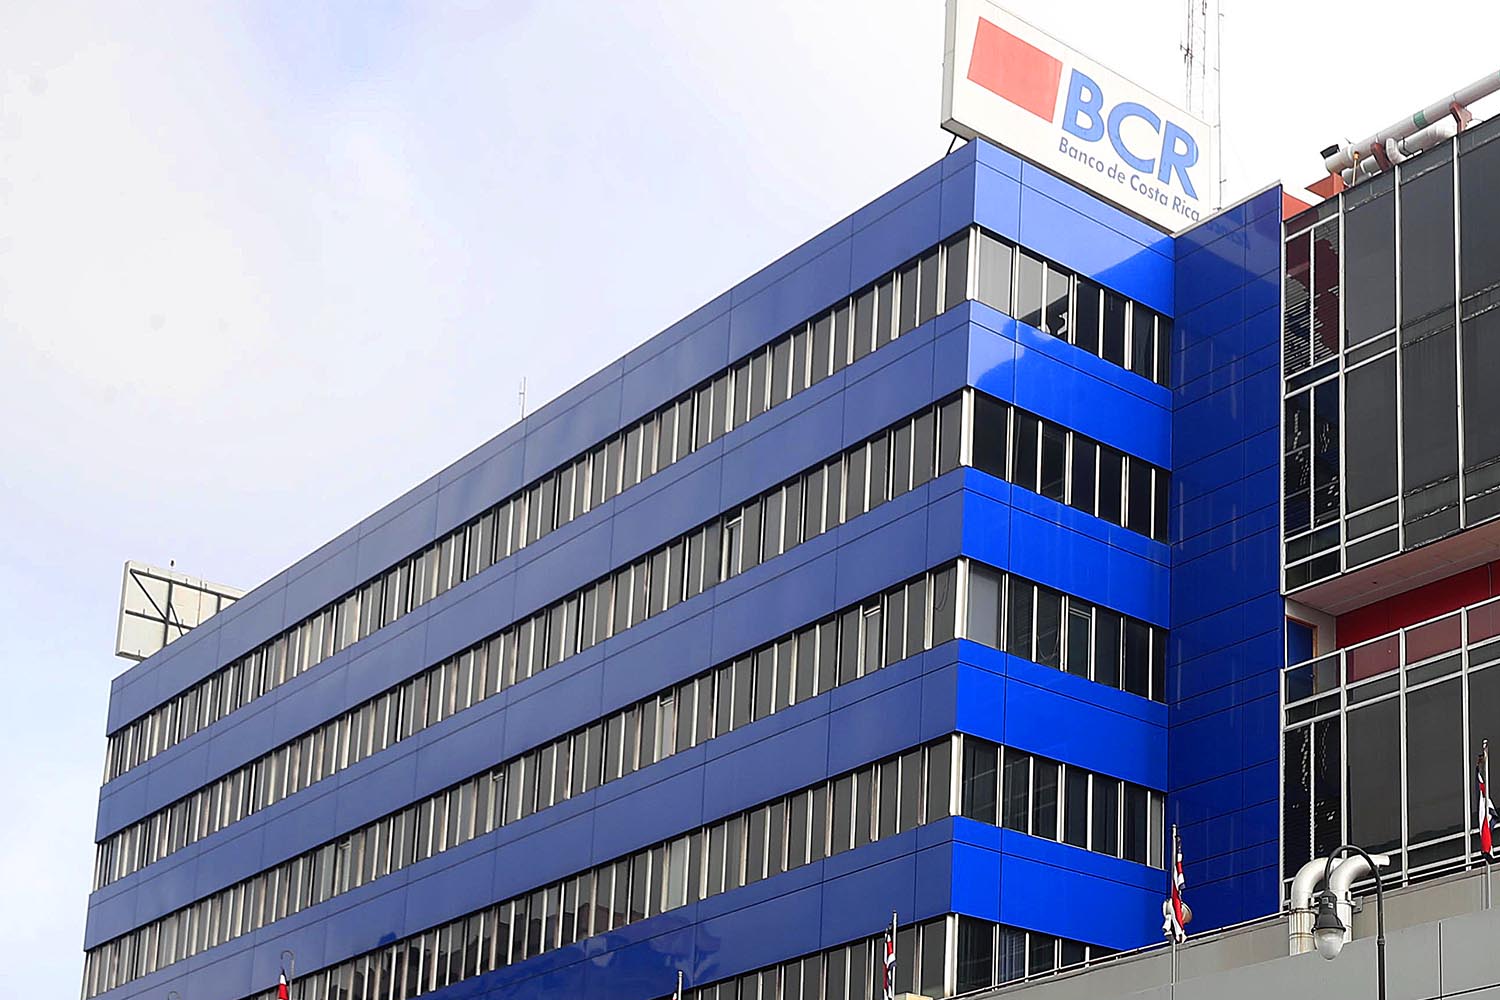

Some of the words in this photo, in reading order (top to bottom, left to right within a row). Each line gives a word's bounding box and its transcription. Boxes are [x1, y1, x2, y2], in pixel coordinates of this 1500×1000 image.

[1058, 136, 1105, 173] Banco
[1107, 163, 1126, 184] de
[1130, 174, 1169, 206] Costa
[1171, 195, 1200, 221] Rica
[1062, 67, 1199, 201] BCR
